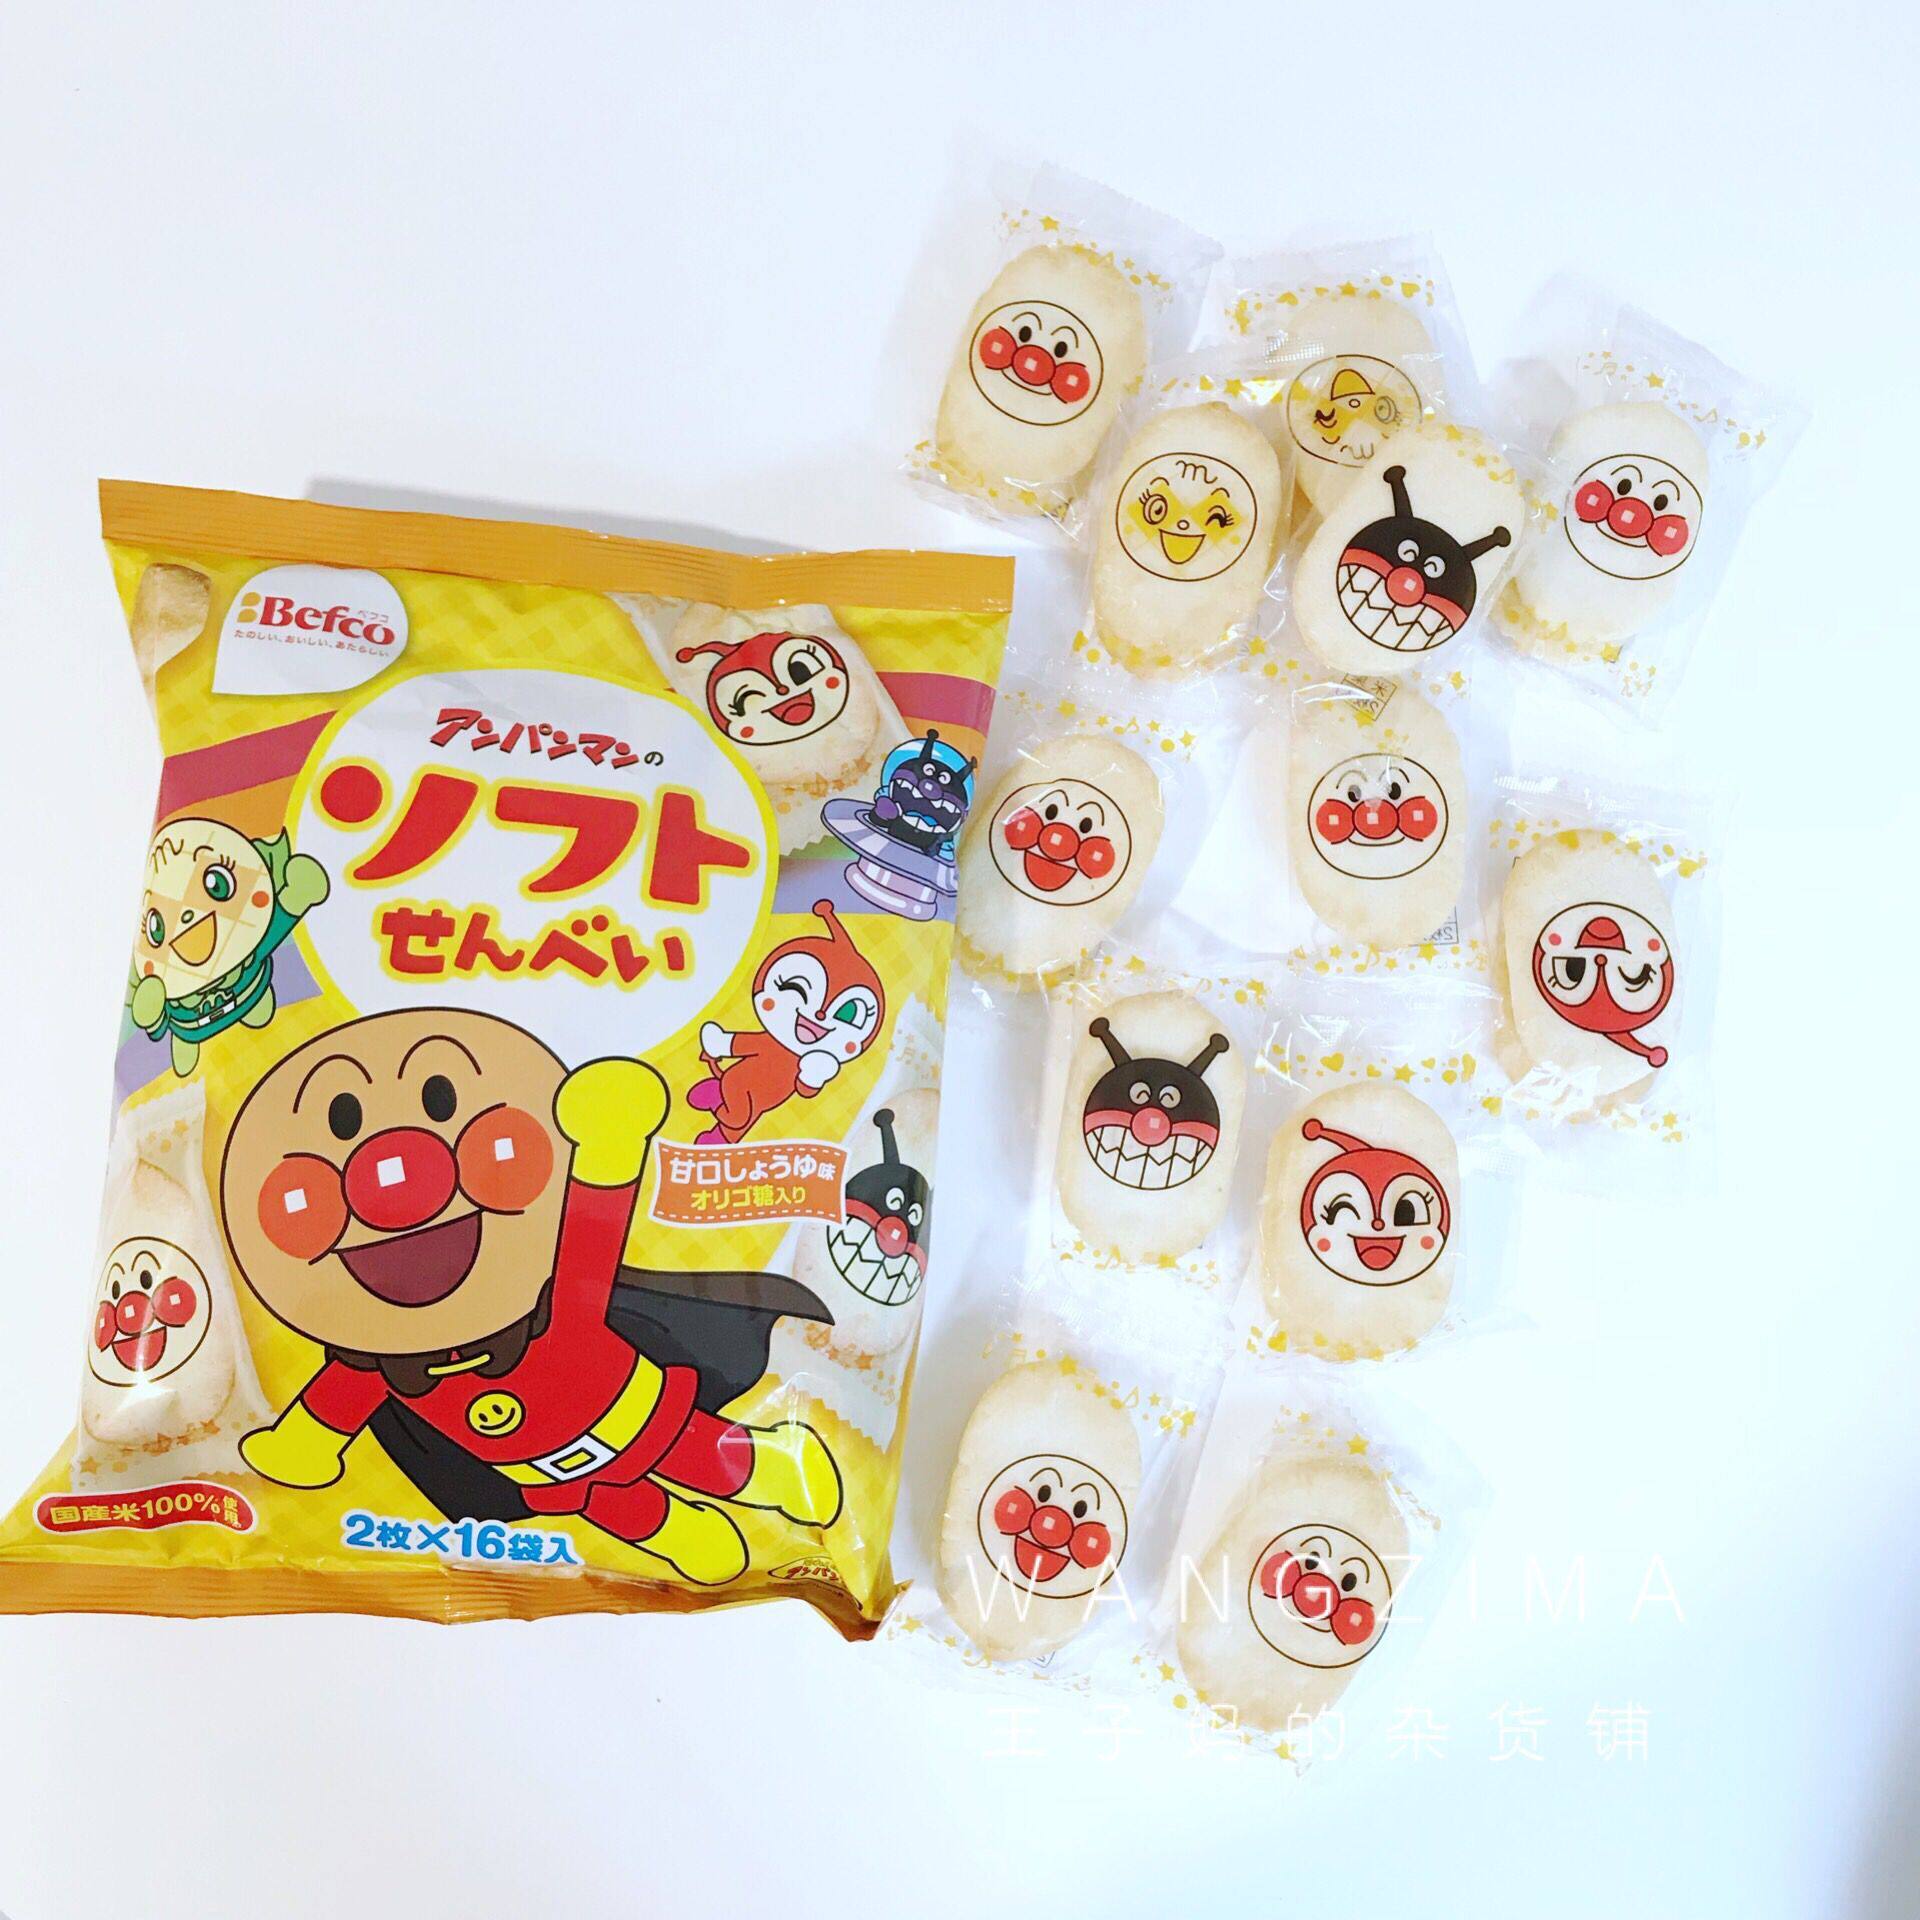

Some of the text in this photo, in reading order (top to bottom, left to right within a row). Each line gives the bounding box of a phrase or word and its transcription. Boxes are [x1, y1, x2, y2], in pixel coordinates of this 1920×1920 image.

[259, 596, 395, 645] Befco
[430, 707, 664, 769] アンパンマンの
[320, 765, 750, 905] ソフト
[381, 907, 686, 983] せんべい
[669, 1154, 836, 1185] 甘口しょうゆ味
[690, 1184, 806, 1211] オリゴ糖入り
